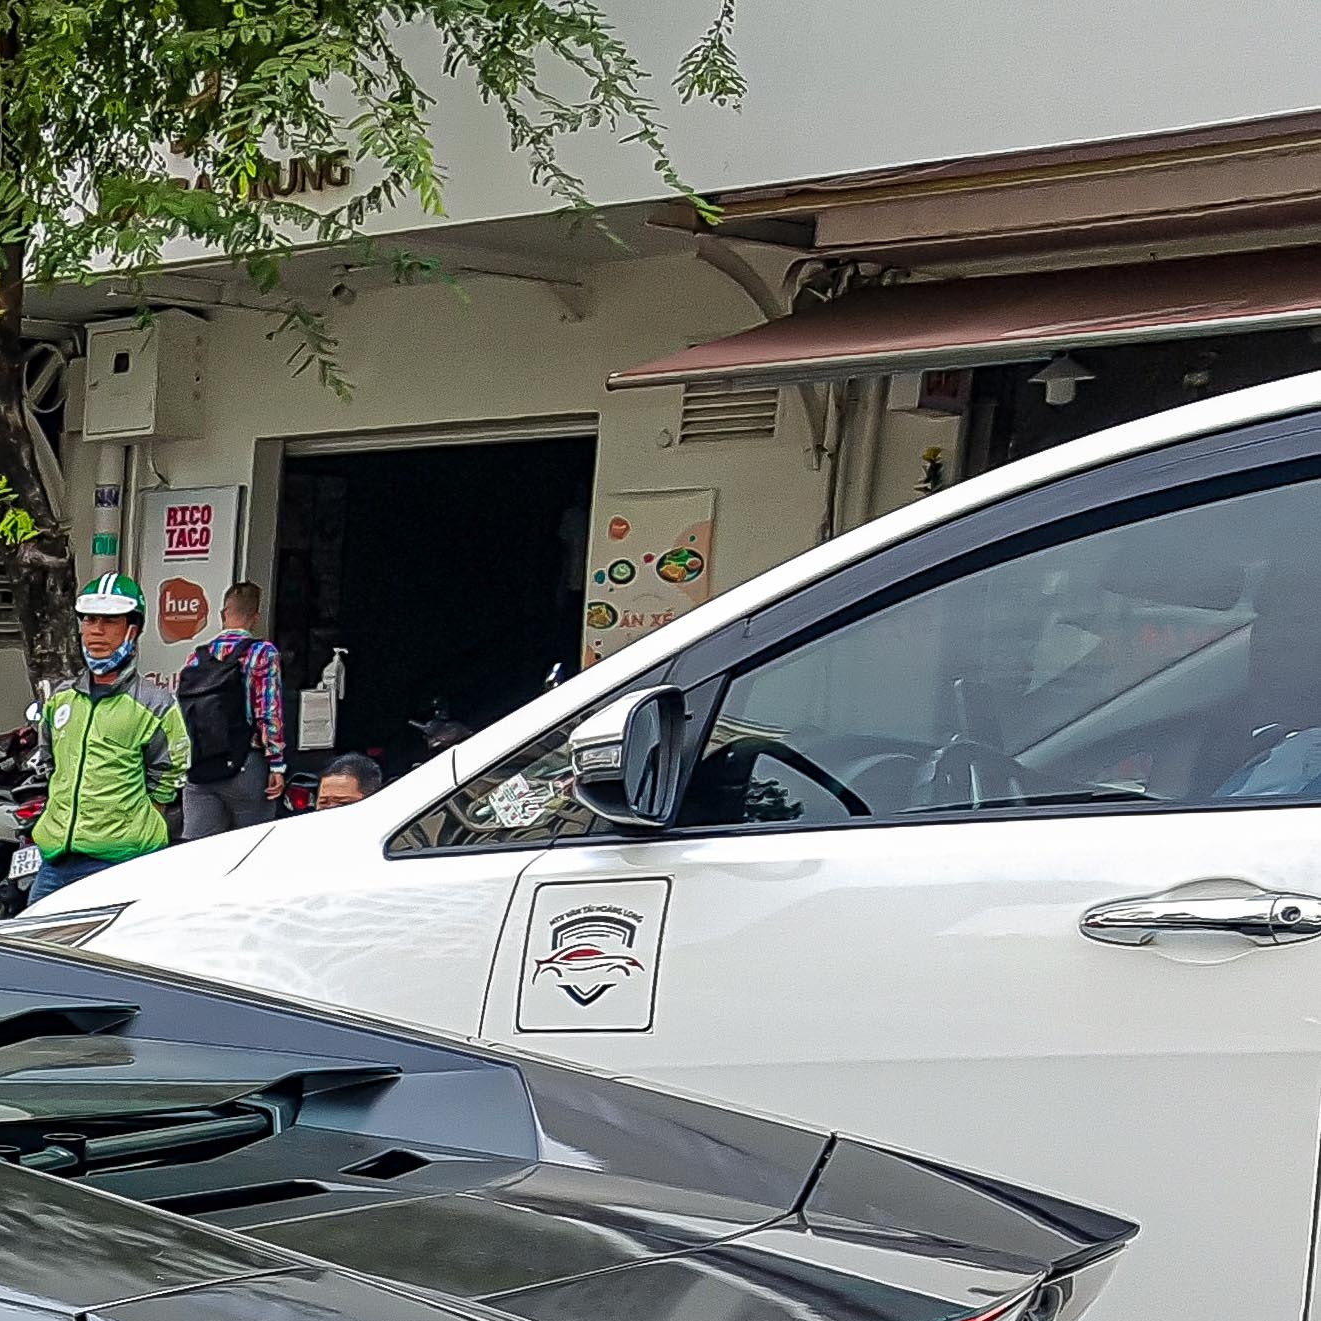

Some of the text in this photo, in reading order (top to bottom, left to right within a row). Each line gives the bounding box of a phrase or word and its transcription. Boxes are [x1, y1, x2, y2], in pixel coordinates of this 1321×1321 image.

[166, 504, 213, 528] RICO
[165, 526, 212, 549] TACO
[165, 591, 200, 613] hue
